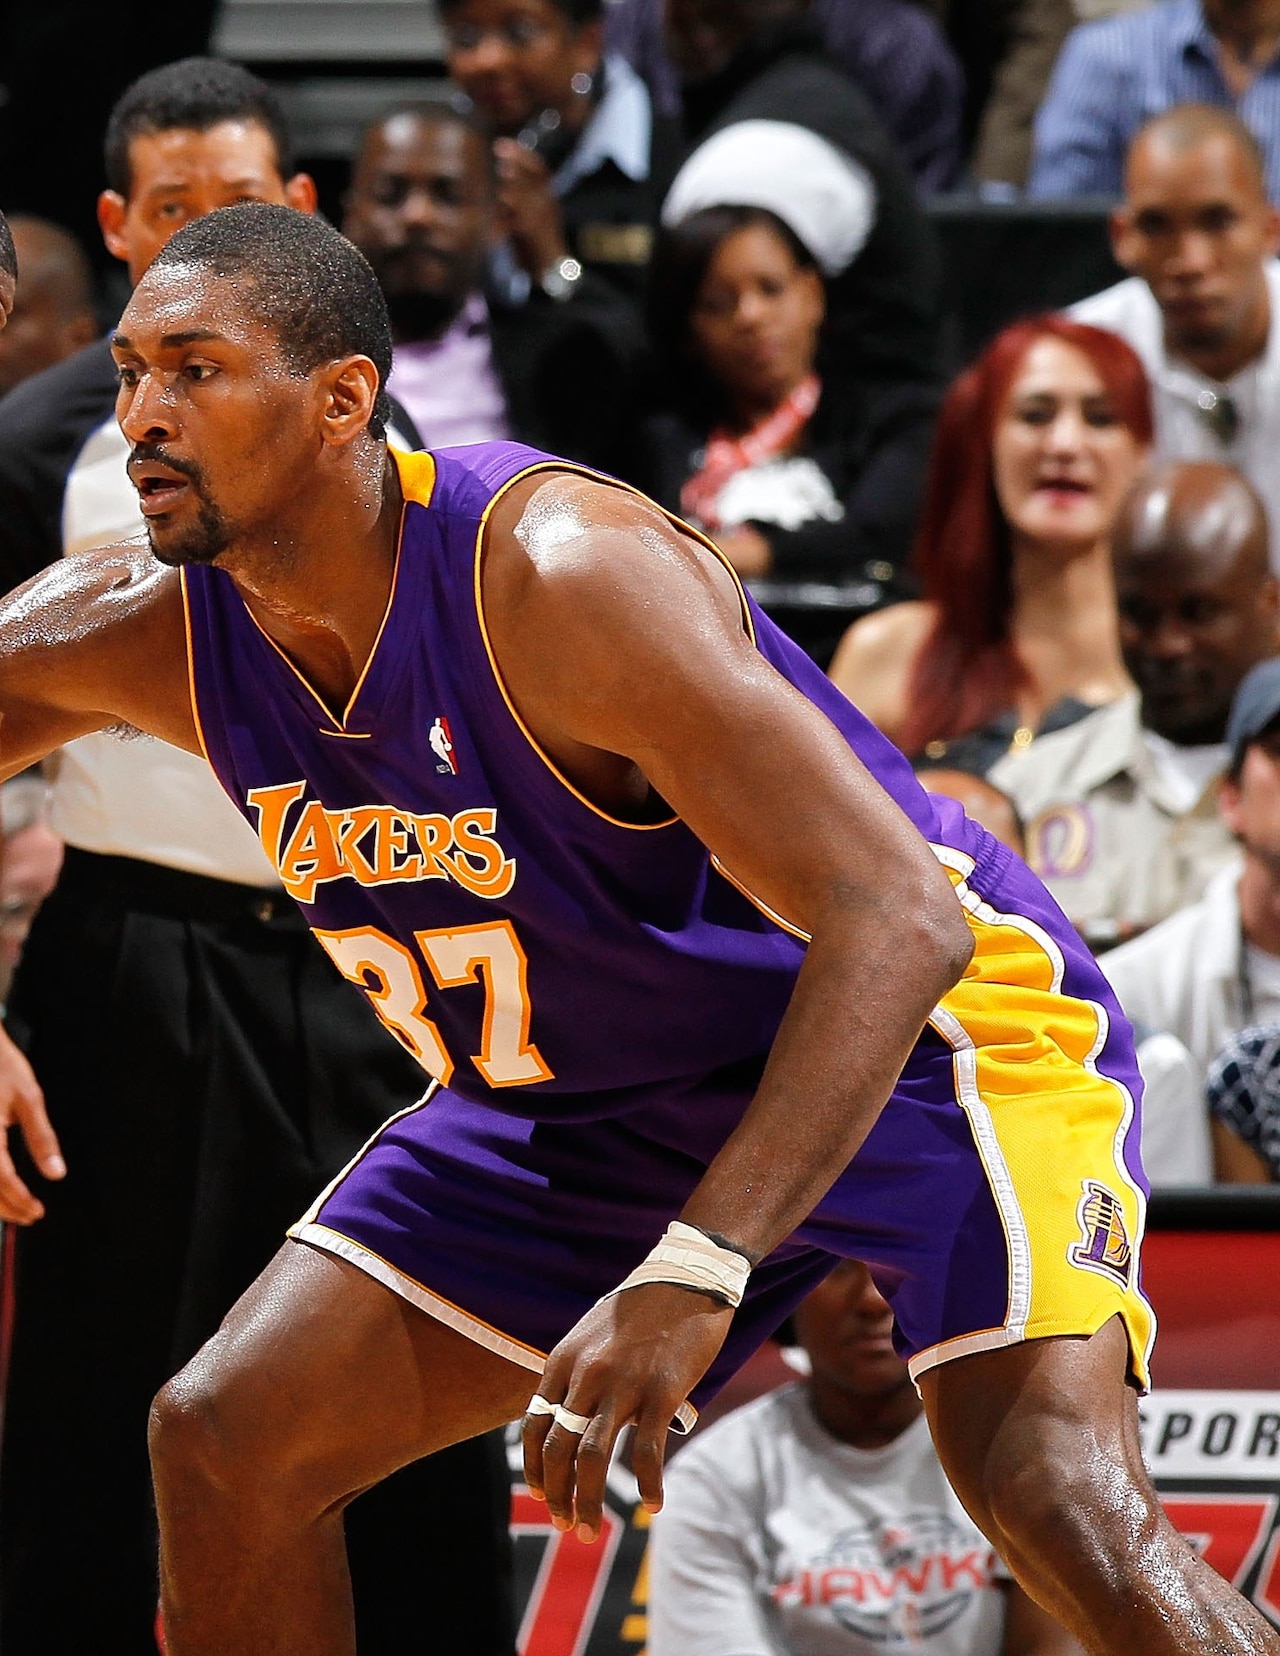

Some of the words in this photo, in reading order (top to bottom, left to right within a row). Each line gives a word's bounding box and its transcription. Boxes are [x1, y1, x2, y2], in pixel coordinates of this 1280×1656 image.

[246, 779, 516, 904] LAKERS
[309, 919, 555, 1088] 37
[1140, 1411, 1280, 1457] POR
